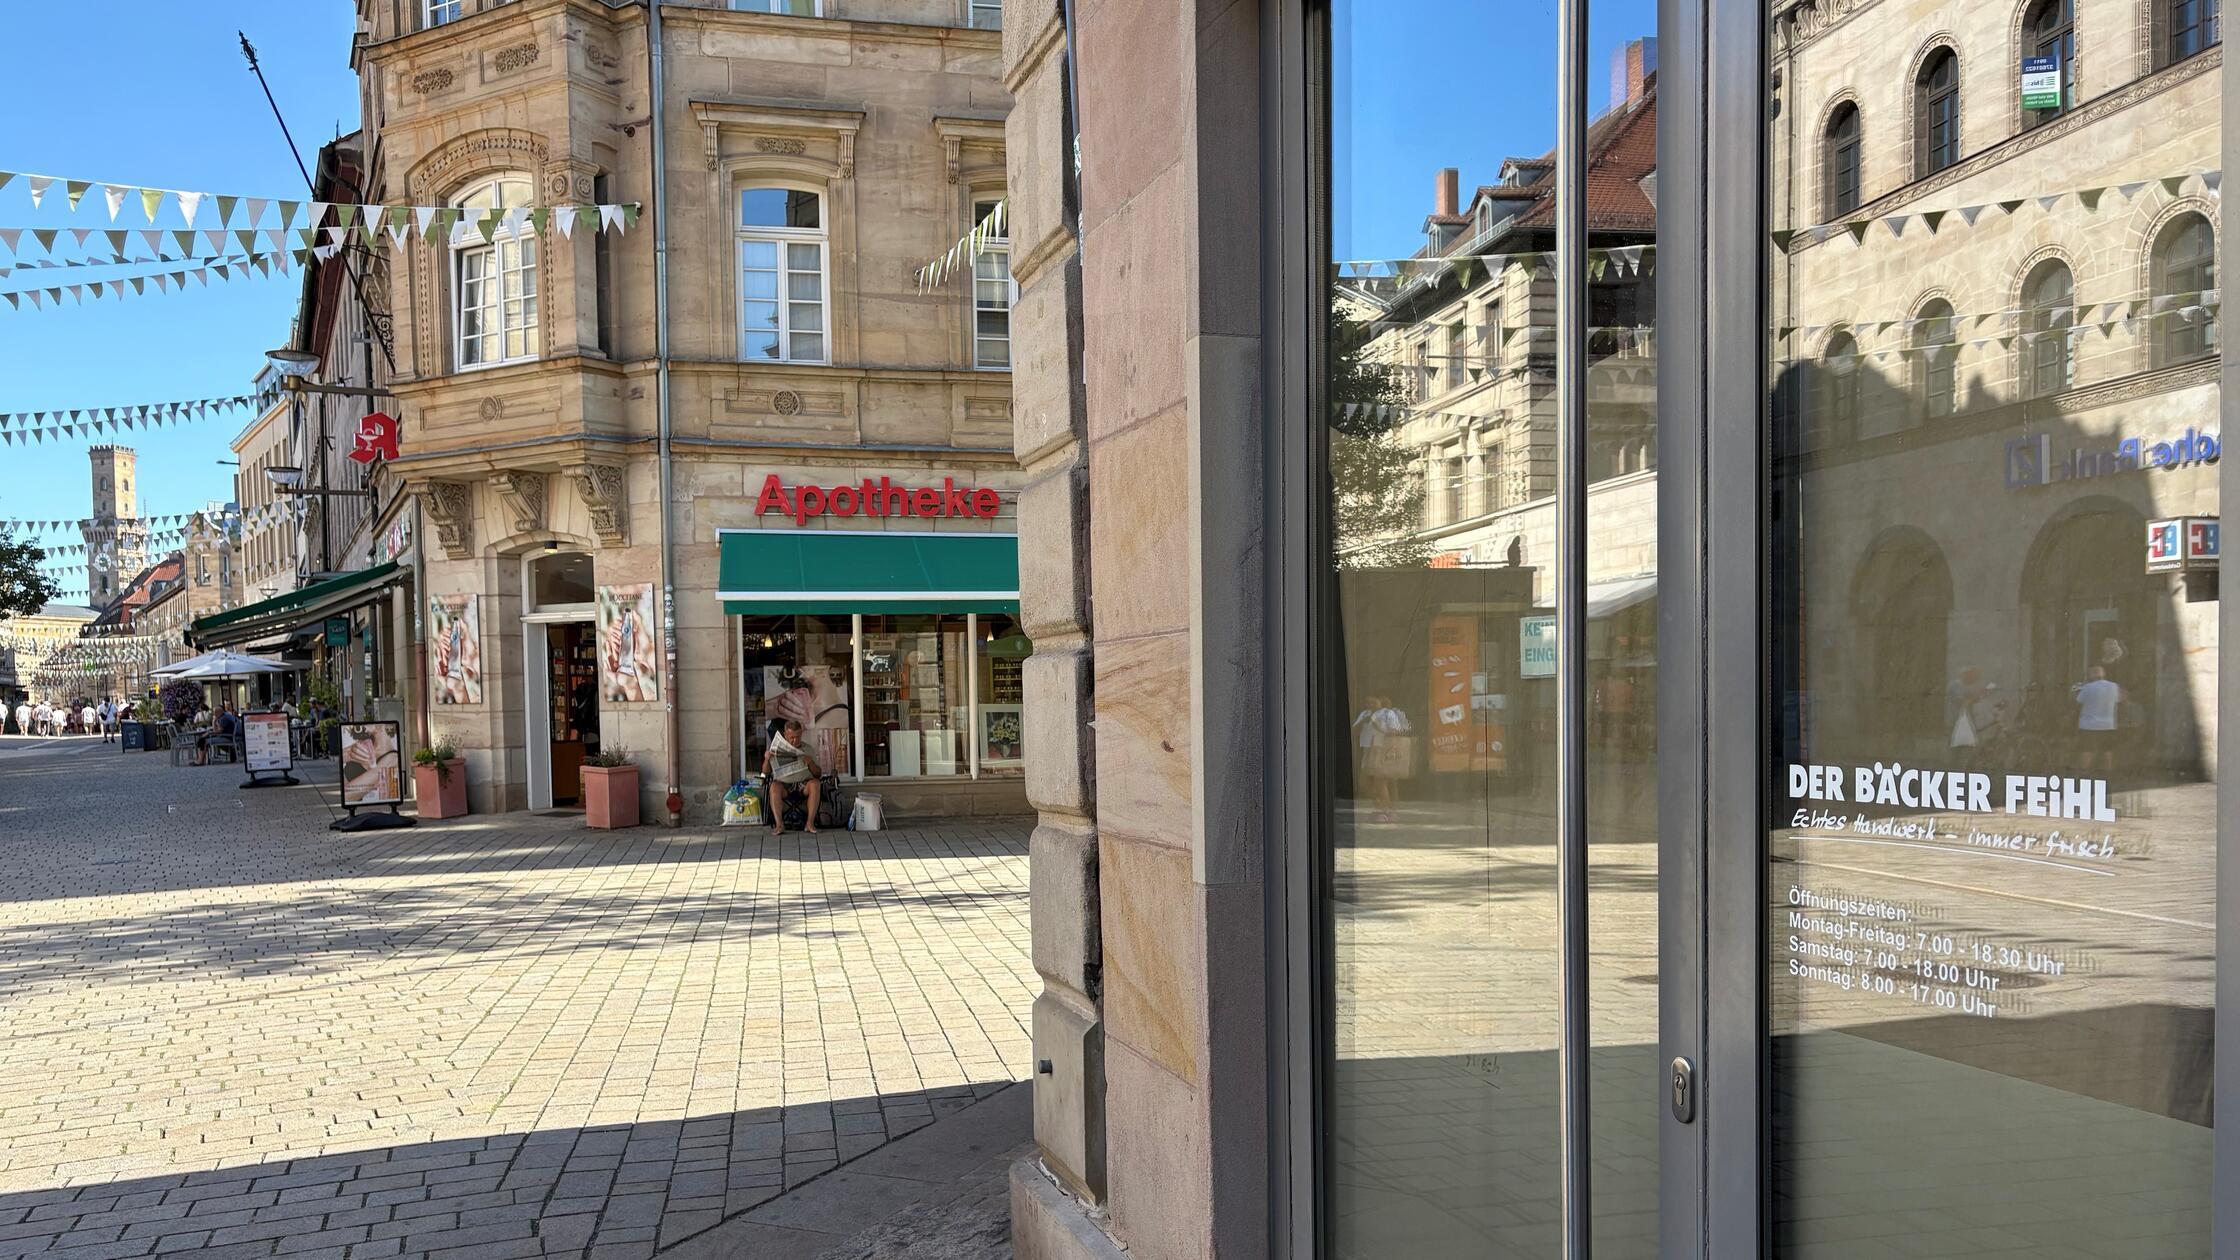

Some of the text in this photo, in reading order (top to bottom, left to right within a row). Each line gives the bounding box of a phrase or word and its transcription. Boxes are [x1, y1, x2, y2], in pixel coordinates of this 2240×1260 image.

[754, 474, 1000, 526] Apotheke
[1524, 622, 1555, 637] KE
[1789, 764, 1845, 801] DER
[1855, 762, 1992, 812] BÄCKER
[1791, 808, 1847, 830] Echtes
[1853, 812, 1936, 840] Handwerk
[1968, 828, 2037, 850] immer
[2045, 830, 2115, 858] frisch
[1789, 885, 1912, 923] Öffnungszeiten:
[1789, 912, 1910, 951] Montag-Freitag:
[1918, 933, 1952, 955] 7.00
[1971, 944, 2020, 967] 18.30
[2028, 953, 2065, 976] Uhr
[1789, 936, 1858, 967] Samstag:
[1864, 949, 1897, 971] 7.00
[1914, 959, 1959, 983] 18.00
[1965, 970, 2000, 992] Uhr
[1789, 959, 1856, 990] Sonntag:
[1861, 974, 1894, 995] 8.00
[1911, 985, 1956, 1009] 17.00
[1962, 995, 1996, 1018] Uhr
